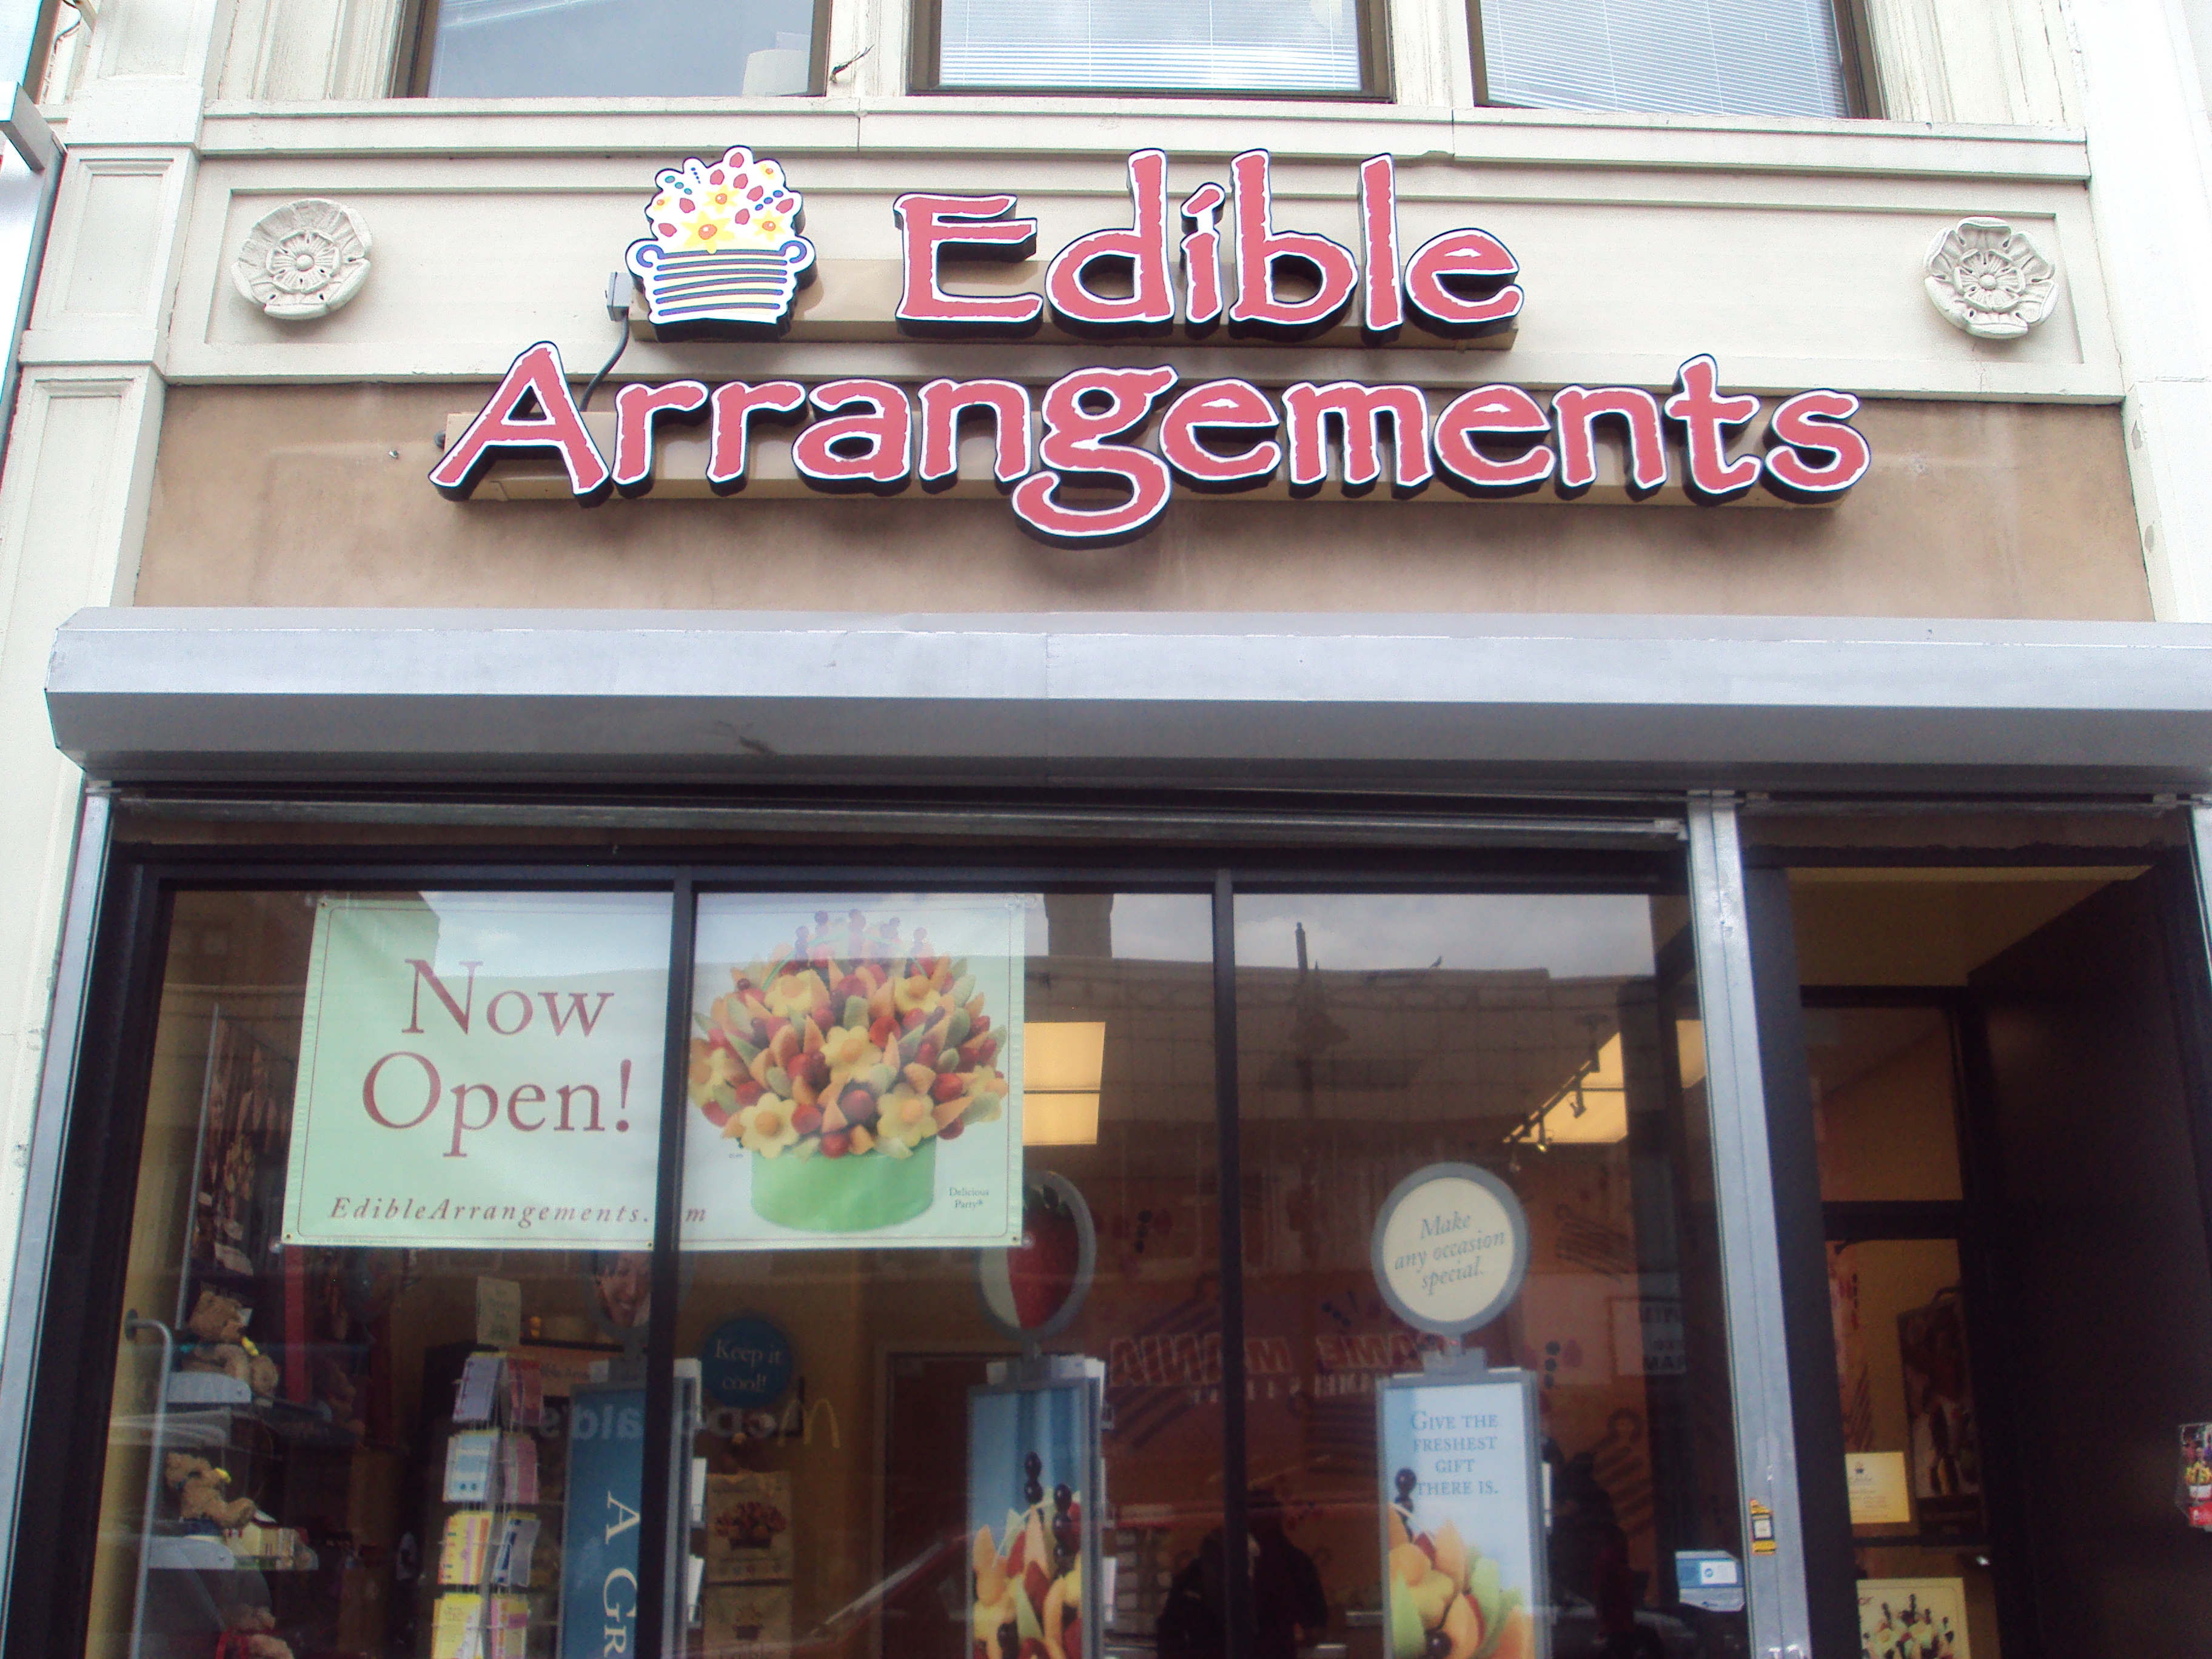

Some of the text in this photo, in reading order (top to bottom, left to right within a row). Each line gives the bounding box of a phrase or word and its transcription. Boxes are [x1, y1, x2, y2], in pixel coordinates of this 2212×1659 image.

[894, 147, 1523, 332] Edible
[430, 340, 1871, 539] Arrangements
[401, 959, 615, 1039] Now
[361, 1050, 632, 1159] Open!
[329, 1196, 708, 1229] EdibleArrangements.m
[1419, 1211, 1471, 1240] Make
[1395, 1229, 1506, 1273] any occasion
[714, 1338, 783, 1369] Keep it
[1413, 1435, 1498, 1453] FRESHEST
[1435, 1458, 1476, 1473] GIFT
[1417, 1481, 1472, 1496] THERE
[605, 1490, 640, 1545] A
